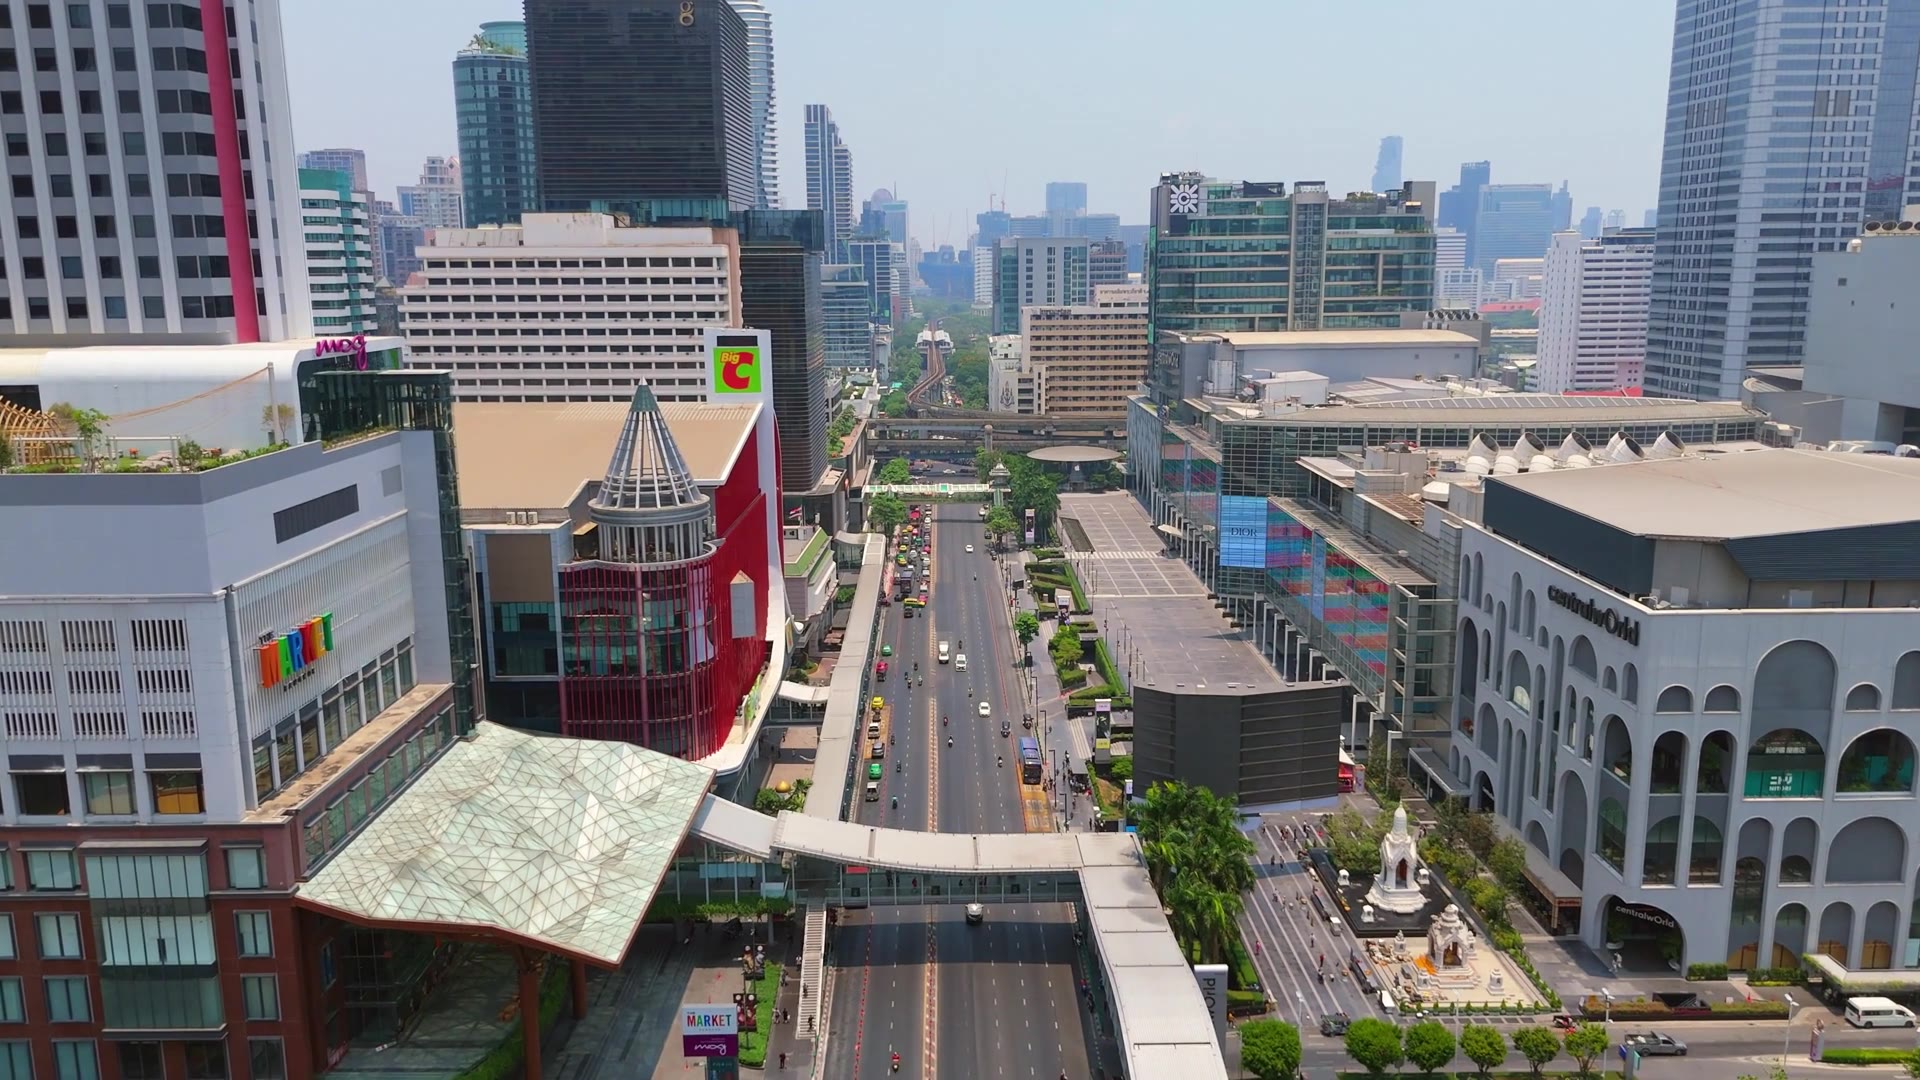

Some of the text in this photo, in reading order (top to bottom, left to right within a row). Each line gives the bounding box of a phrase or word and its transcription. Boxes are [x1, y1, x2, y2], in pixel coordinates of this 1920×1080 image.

[720, 351, 740, 365] Big
[722, 351, 754, 390] C
[1231, 527, 1257, 537] DIOR
[256, 611, 334, 689] MARKET
[1615, 905, 1675, 928] centralwOrld
[687, 1014, 732, 1027] MARKET
